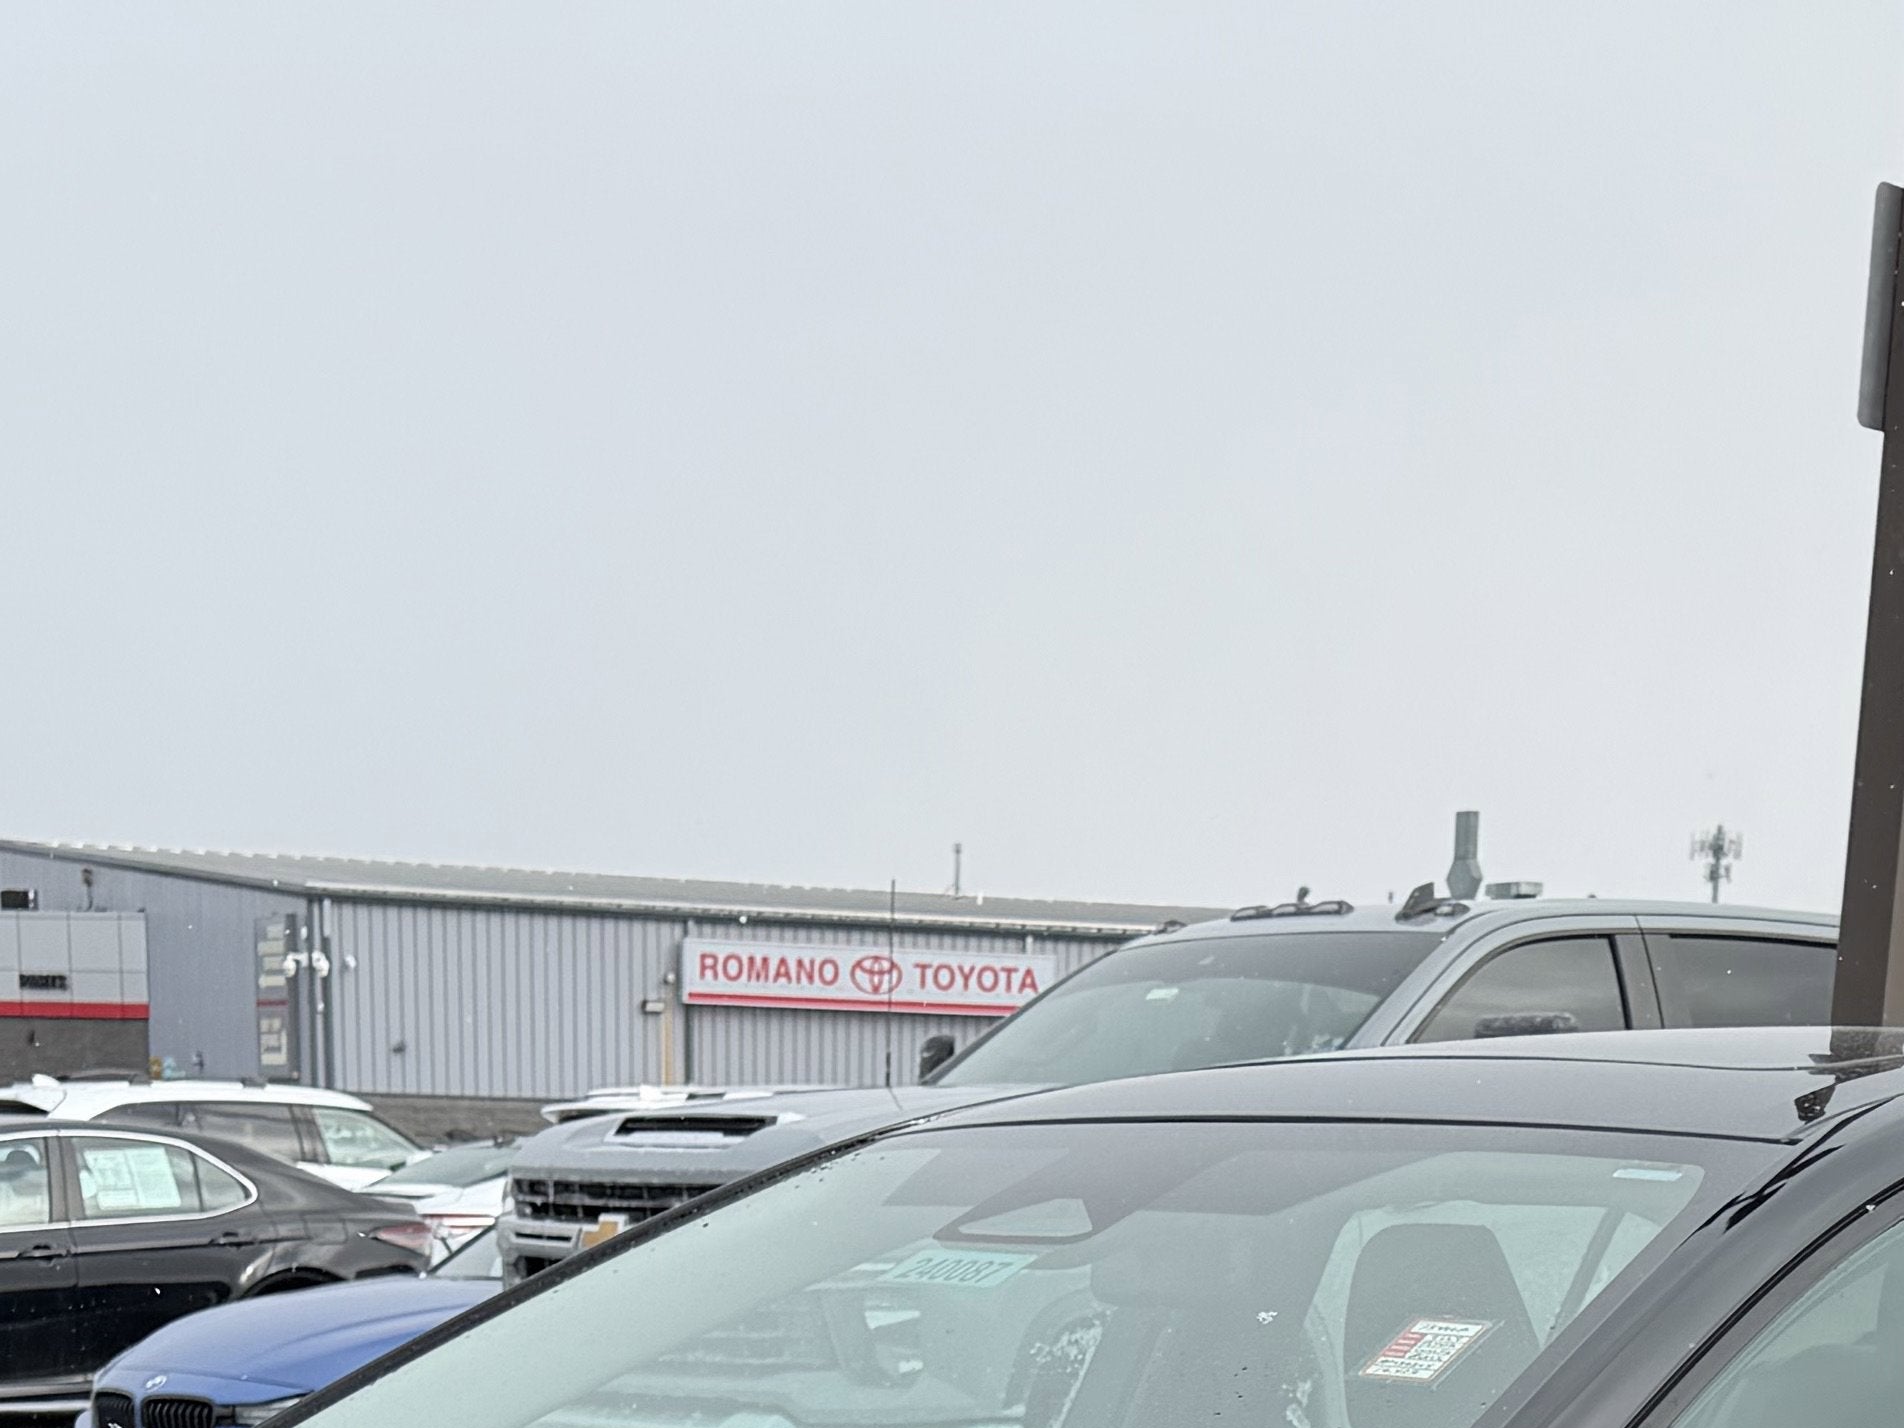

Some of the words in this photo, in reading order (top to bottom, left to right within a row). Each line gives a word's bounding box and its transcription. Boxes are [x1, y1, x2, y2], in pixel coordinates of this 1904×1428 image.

[698, 952, 840, 987] ROMANO
[912, 962, 1039, 995] TOYOTA
[893, 1257, 1014, 1284] 240087
